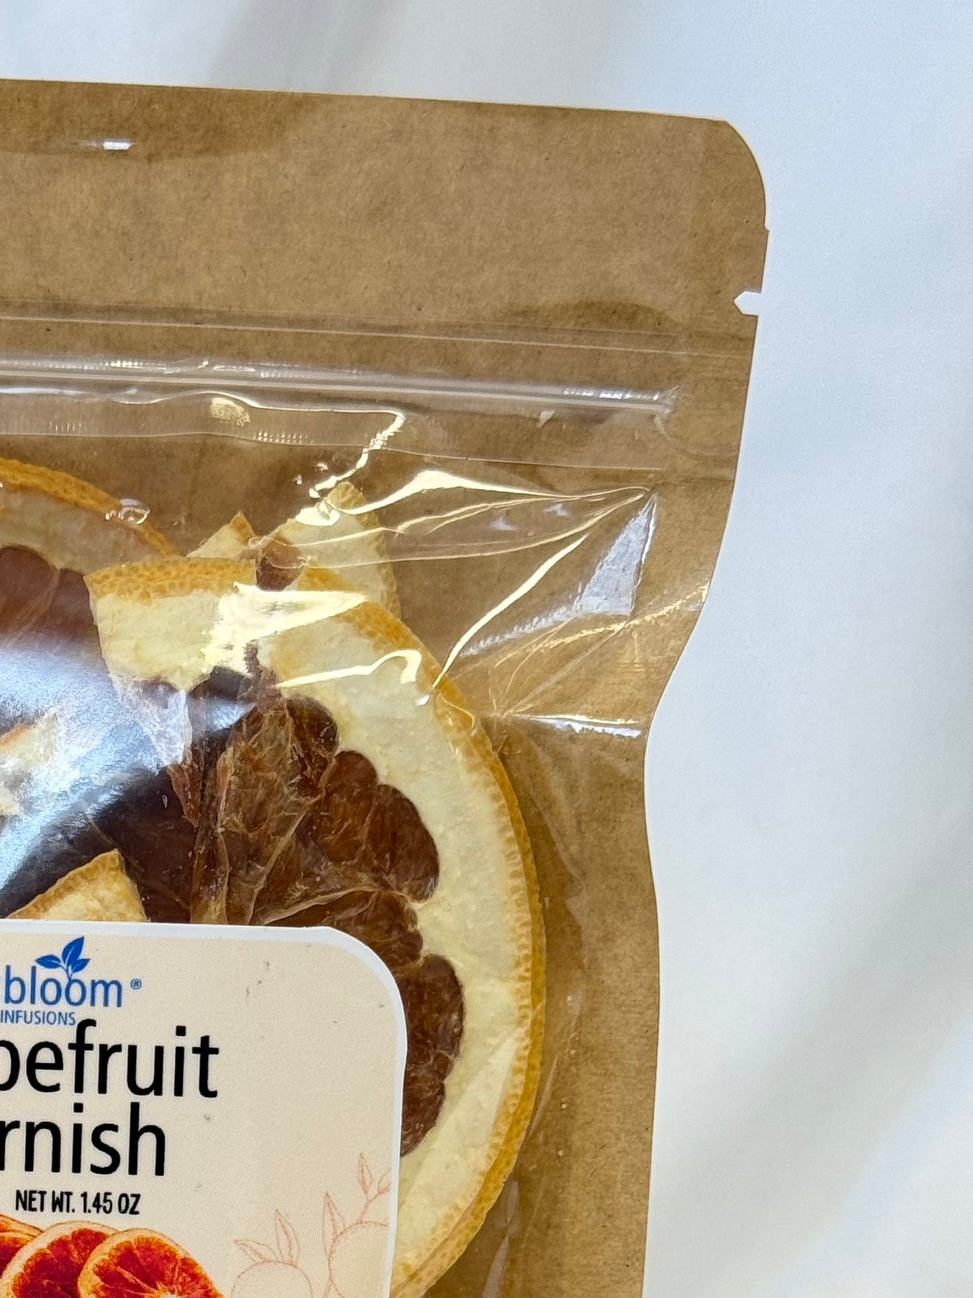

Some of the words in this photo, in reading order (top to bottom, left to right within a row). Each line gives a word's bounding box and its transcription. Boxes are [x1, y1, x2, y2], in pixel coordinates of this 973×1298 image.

[0, 1009, 76, 1026] INFUSIONS
[15, 1189, 47, 1212] NET
[51, 1191, 76, 1213] WT.
[80, 1191, 113, 1214] 1.45
[117, 1193, 141, 1215] OZ
